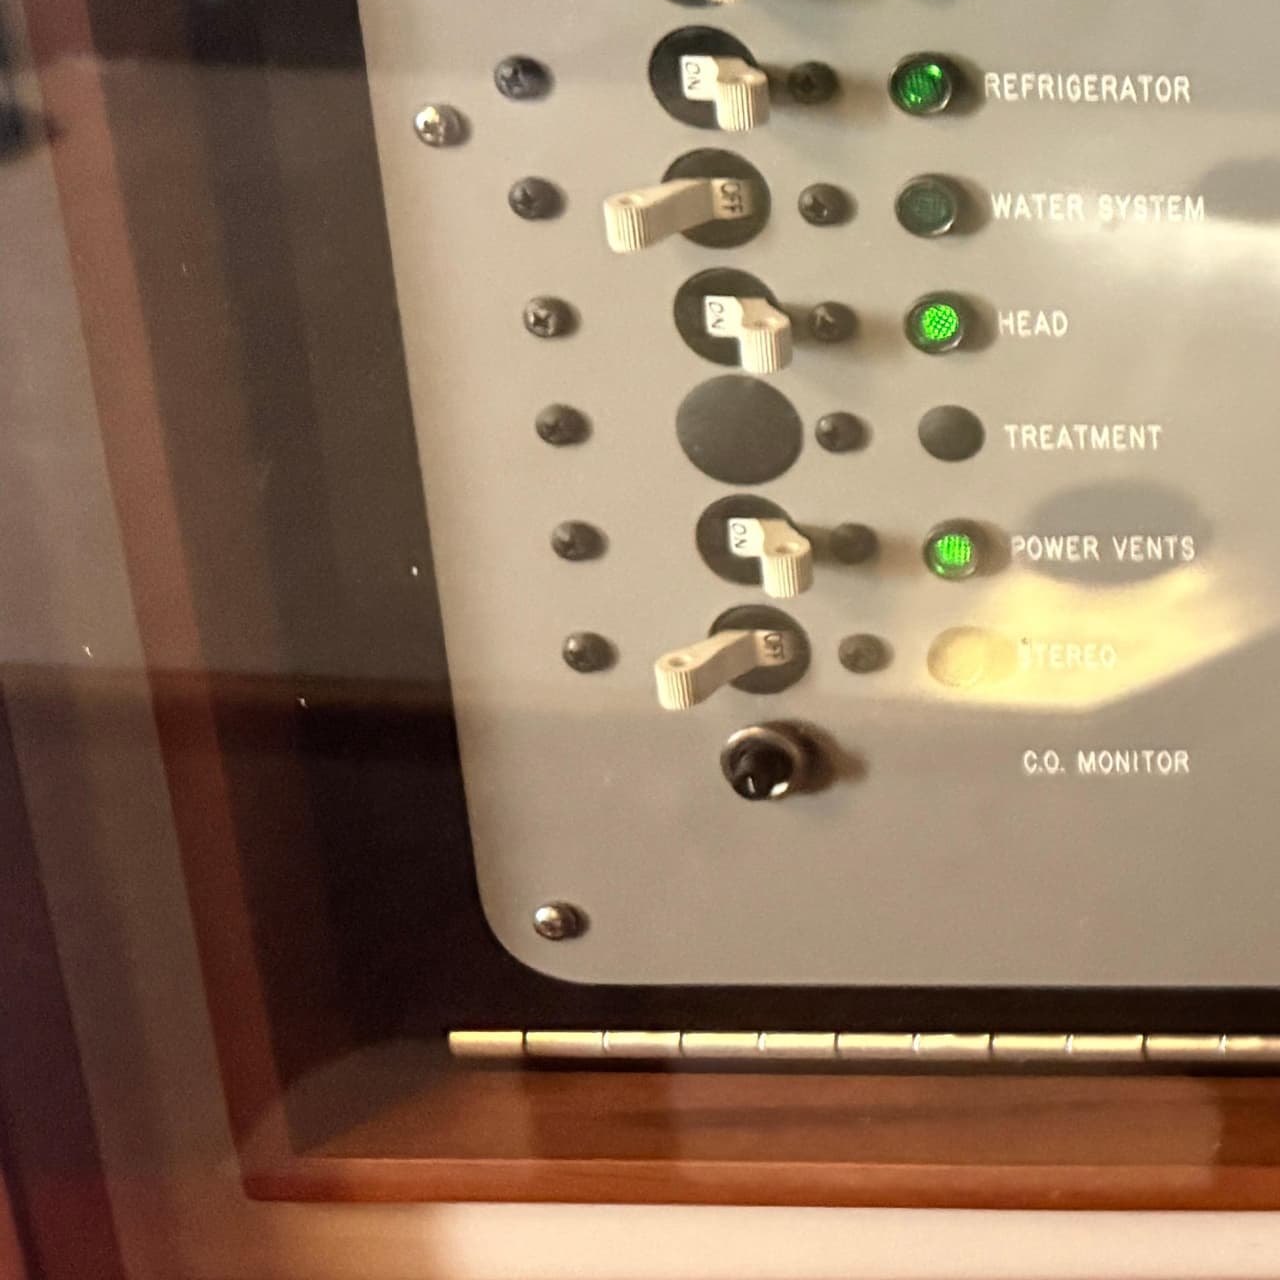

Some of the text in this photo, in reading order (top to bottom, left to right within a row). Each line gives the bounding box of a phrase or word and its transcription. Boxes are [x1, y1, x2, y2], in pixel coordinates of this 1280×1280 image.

[685, 62, 700, 90] ON
[984, 72, 1191, 103] REFRIGERATOR
[719, 182, 743, 216] OFF
[991, 192, 1205, 221] WATER SYSTEM
[709, 301, 724, 330] ON
[998, 310, 1069, 337] HEAD
[1004, 424, 1162, 451] TREATMENT
[732, 522, 747, 548] ON
[1012, 535, 1195, 561] POWER VENTS
[1018, 643, 1117, 669] STEREO
[1023, 750, 1191, 774] C.O. MONITOR
